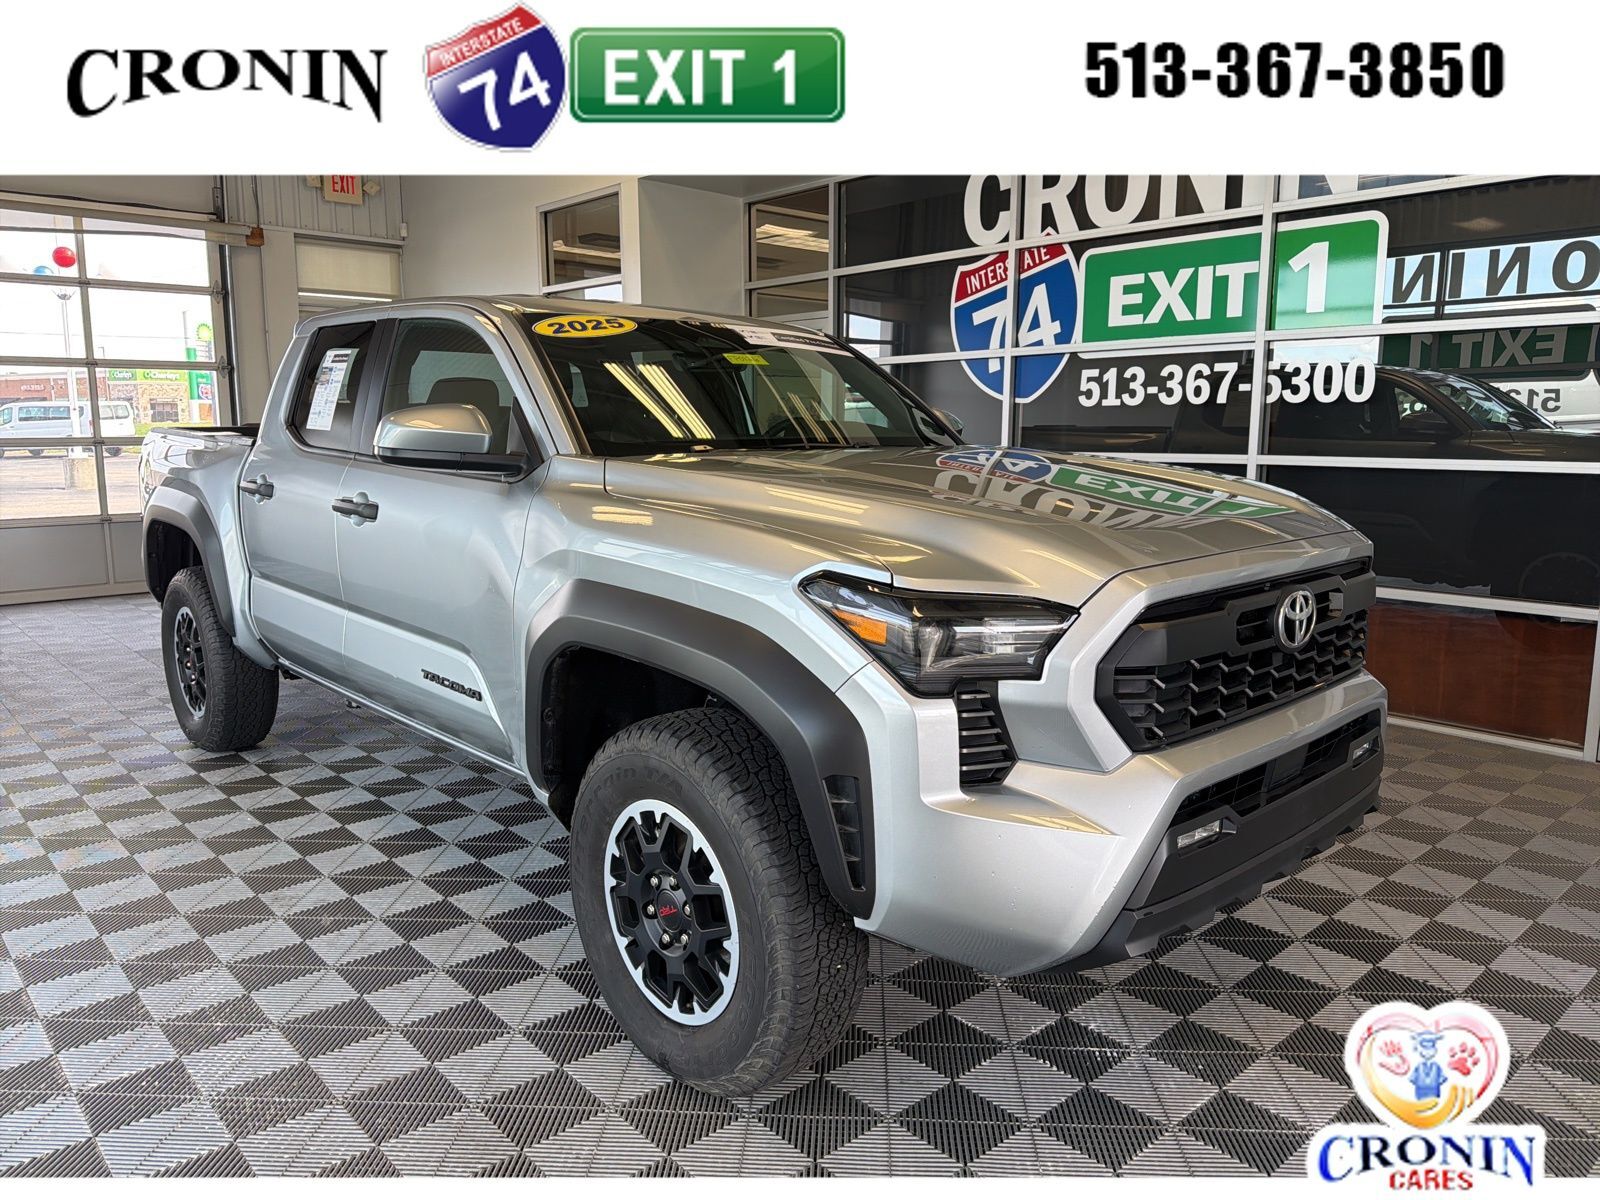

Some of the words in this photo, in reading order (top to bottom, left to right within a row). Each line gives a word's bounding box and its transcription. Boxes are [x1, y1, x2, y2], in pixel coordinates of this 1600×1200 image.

[331, 174, 355, 195] EXIT
[963, 174, 1360, 246] CRON
[966, 247, 1051, 294] INTERSATE
[1107, 260, 1260, 328] EXIT
[1287, 241, 1330, 313] 1
[547, 318, 625, 335] 2025
[972, 282, 1062, 374] 74
[421, 668, 483, 702] TACOMA
